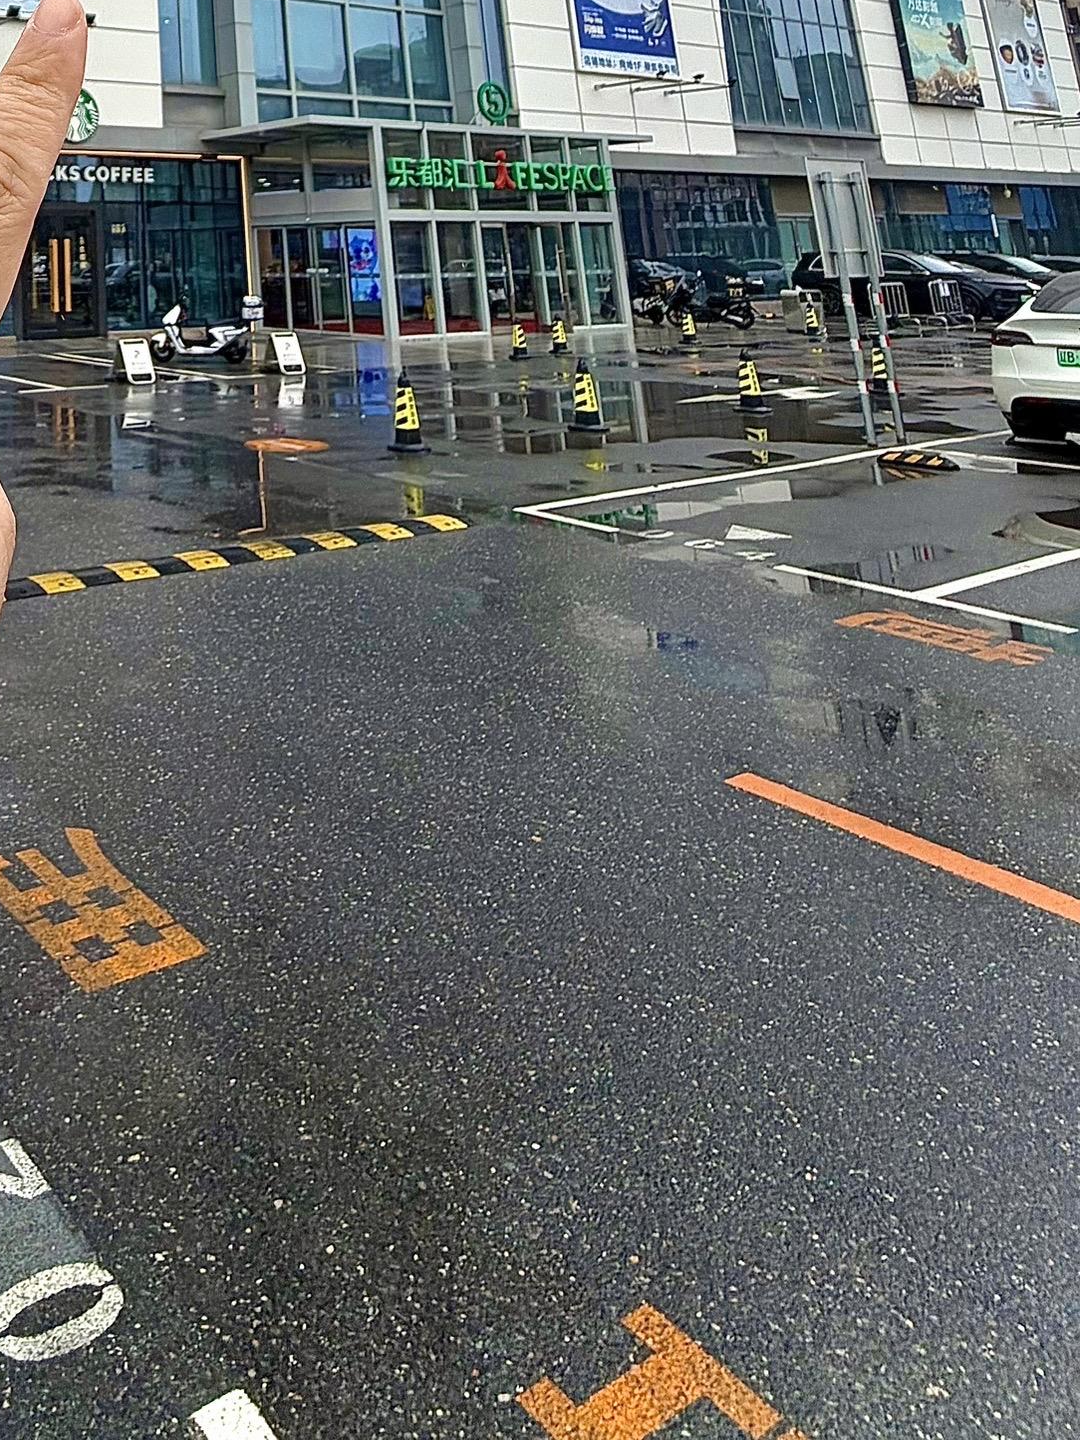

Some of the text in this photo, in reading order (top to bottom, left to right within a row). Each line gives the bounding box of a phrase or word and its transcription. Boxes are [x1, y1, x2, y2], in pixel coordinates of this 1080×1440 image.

[83, 165, 156, 183] COFFEE
[387, 148, 617, 192] 乐都汇 LIFESPACE
